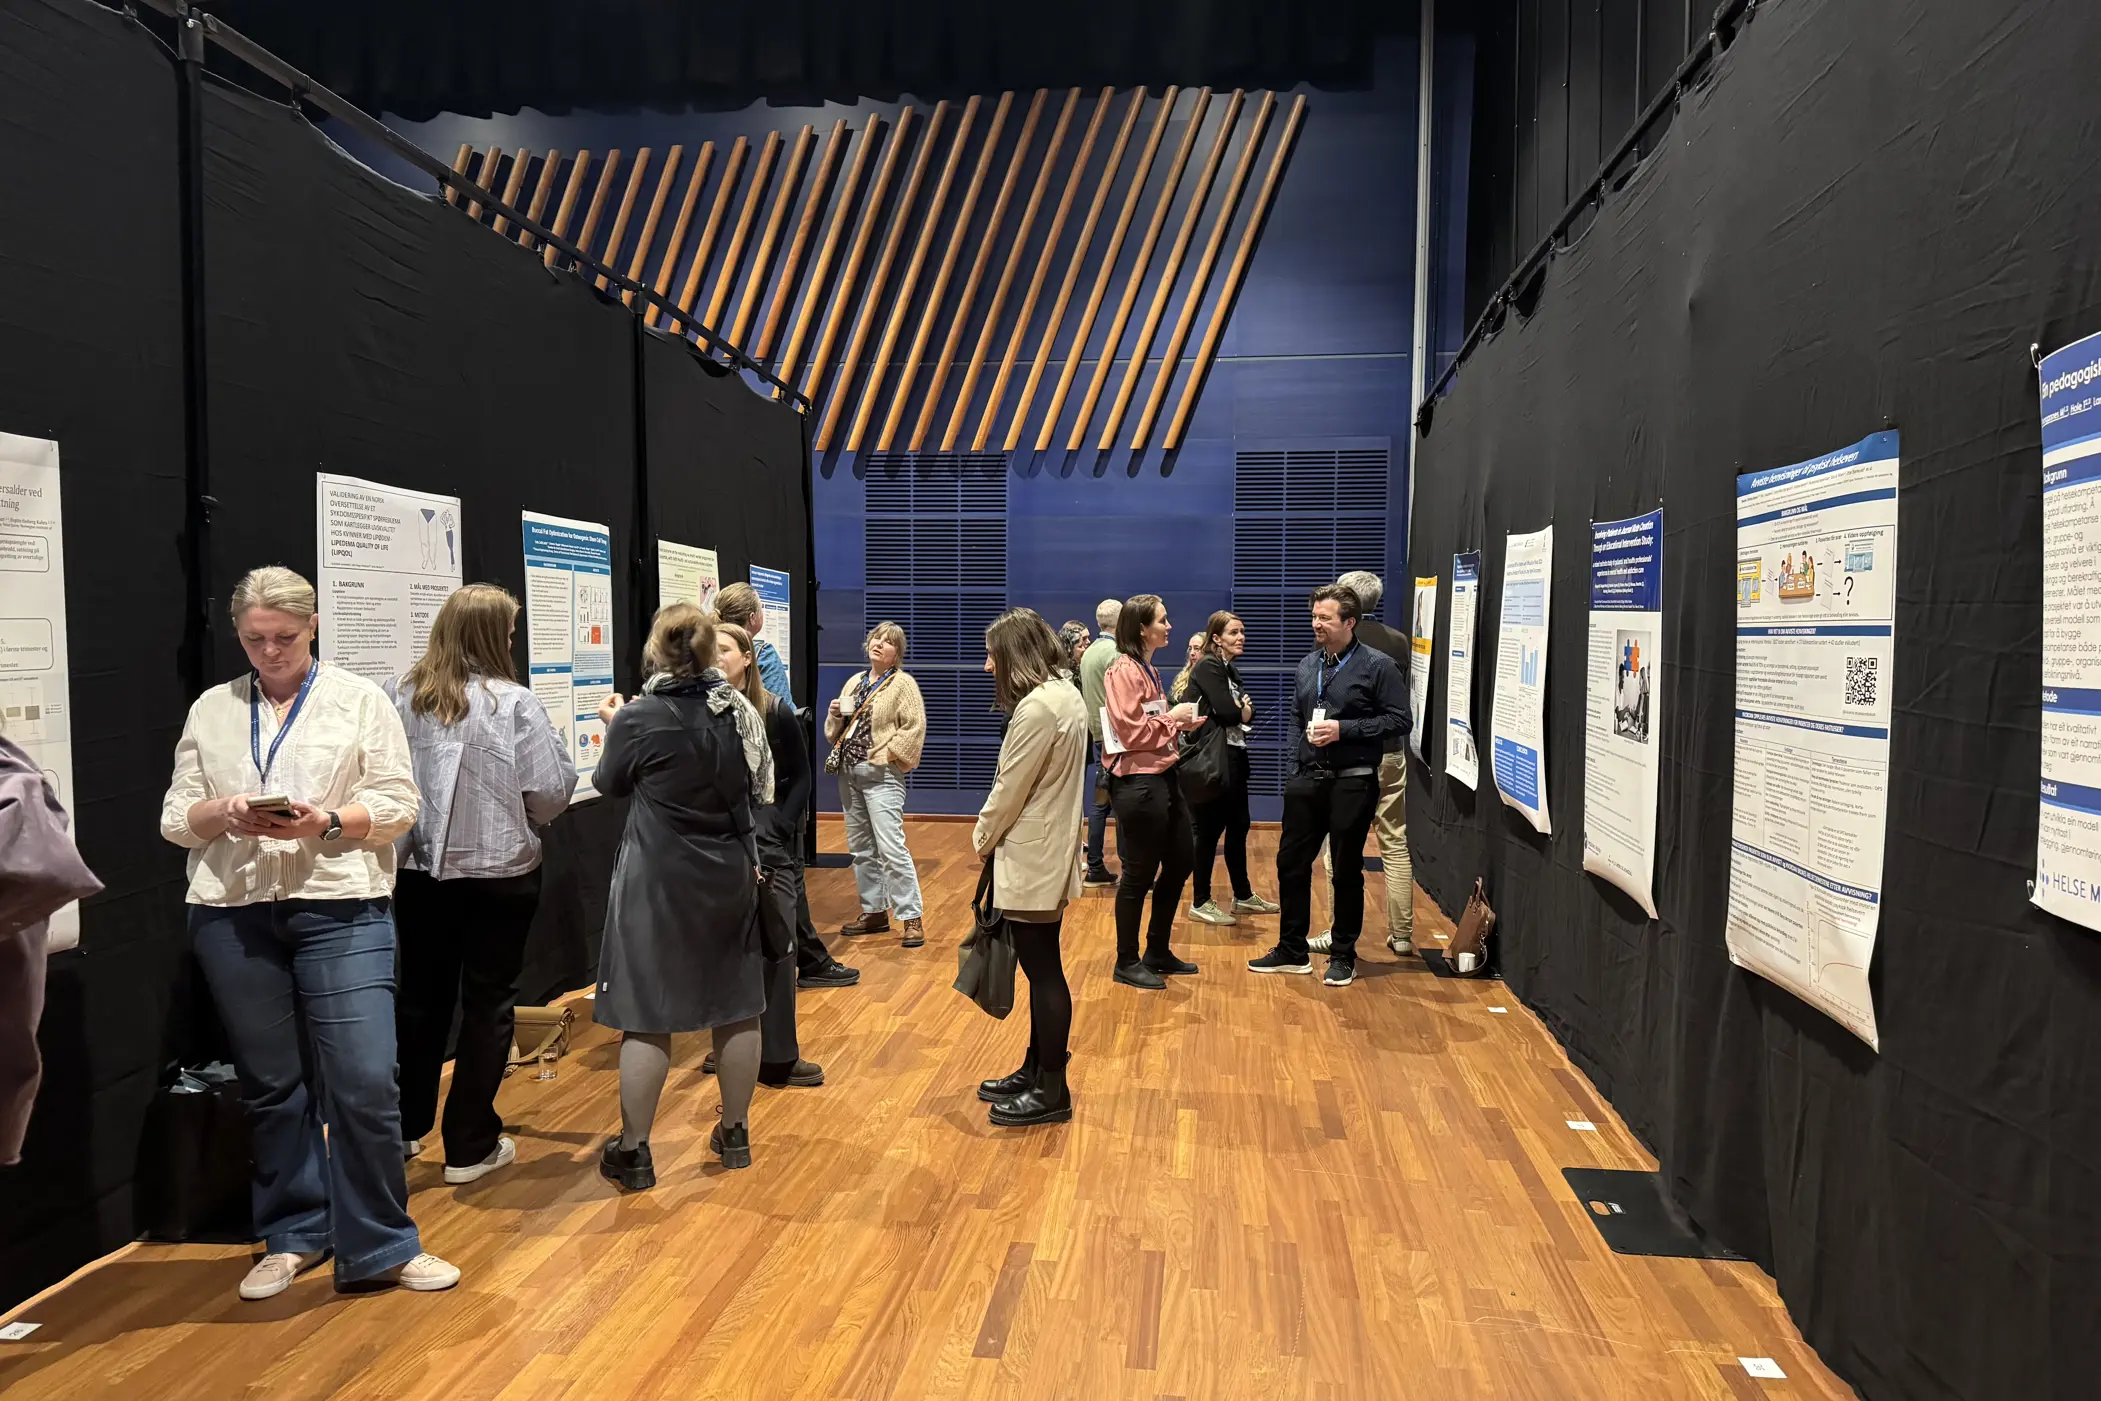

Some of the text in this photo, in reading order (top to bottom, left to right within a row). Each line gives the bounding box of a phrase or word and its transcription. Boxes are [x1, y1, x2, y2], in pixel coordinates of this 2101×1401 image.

[29, 488, 42, 497] ved
[330, 490, 358, 500] VALIDERING
[330, 500, 363, 510] OVERSETTELSE
[2074, 532, 2083, 542] og
[339, 580, 364, 588] BAKGRUNN
[2079, 642, 2096, 652] både
[2053, 872, 2086, 898] HELSE
[1842, 886, 1872, 900] AVVISNING?
